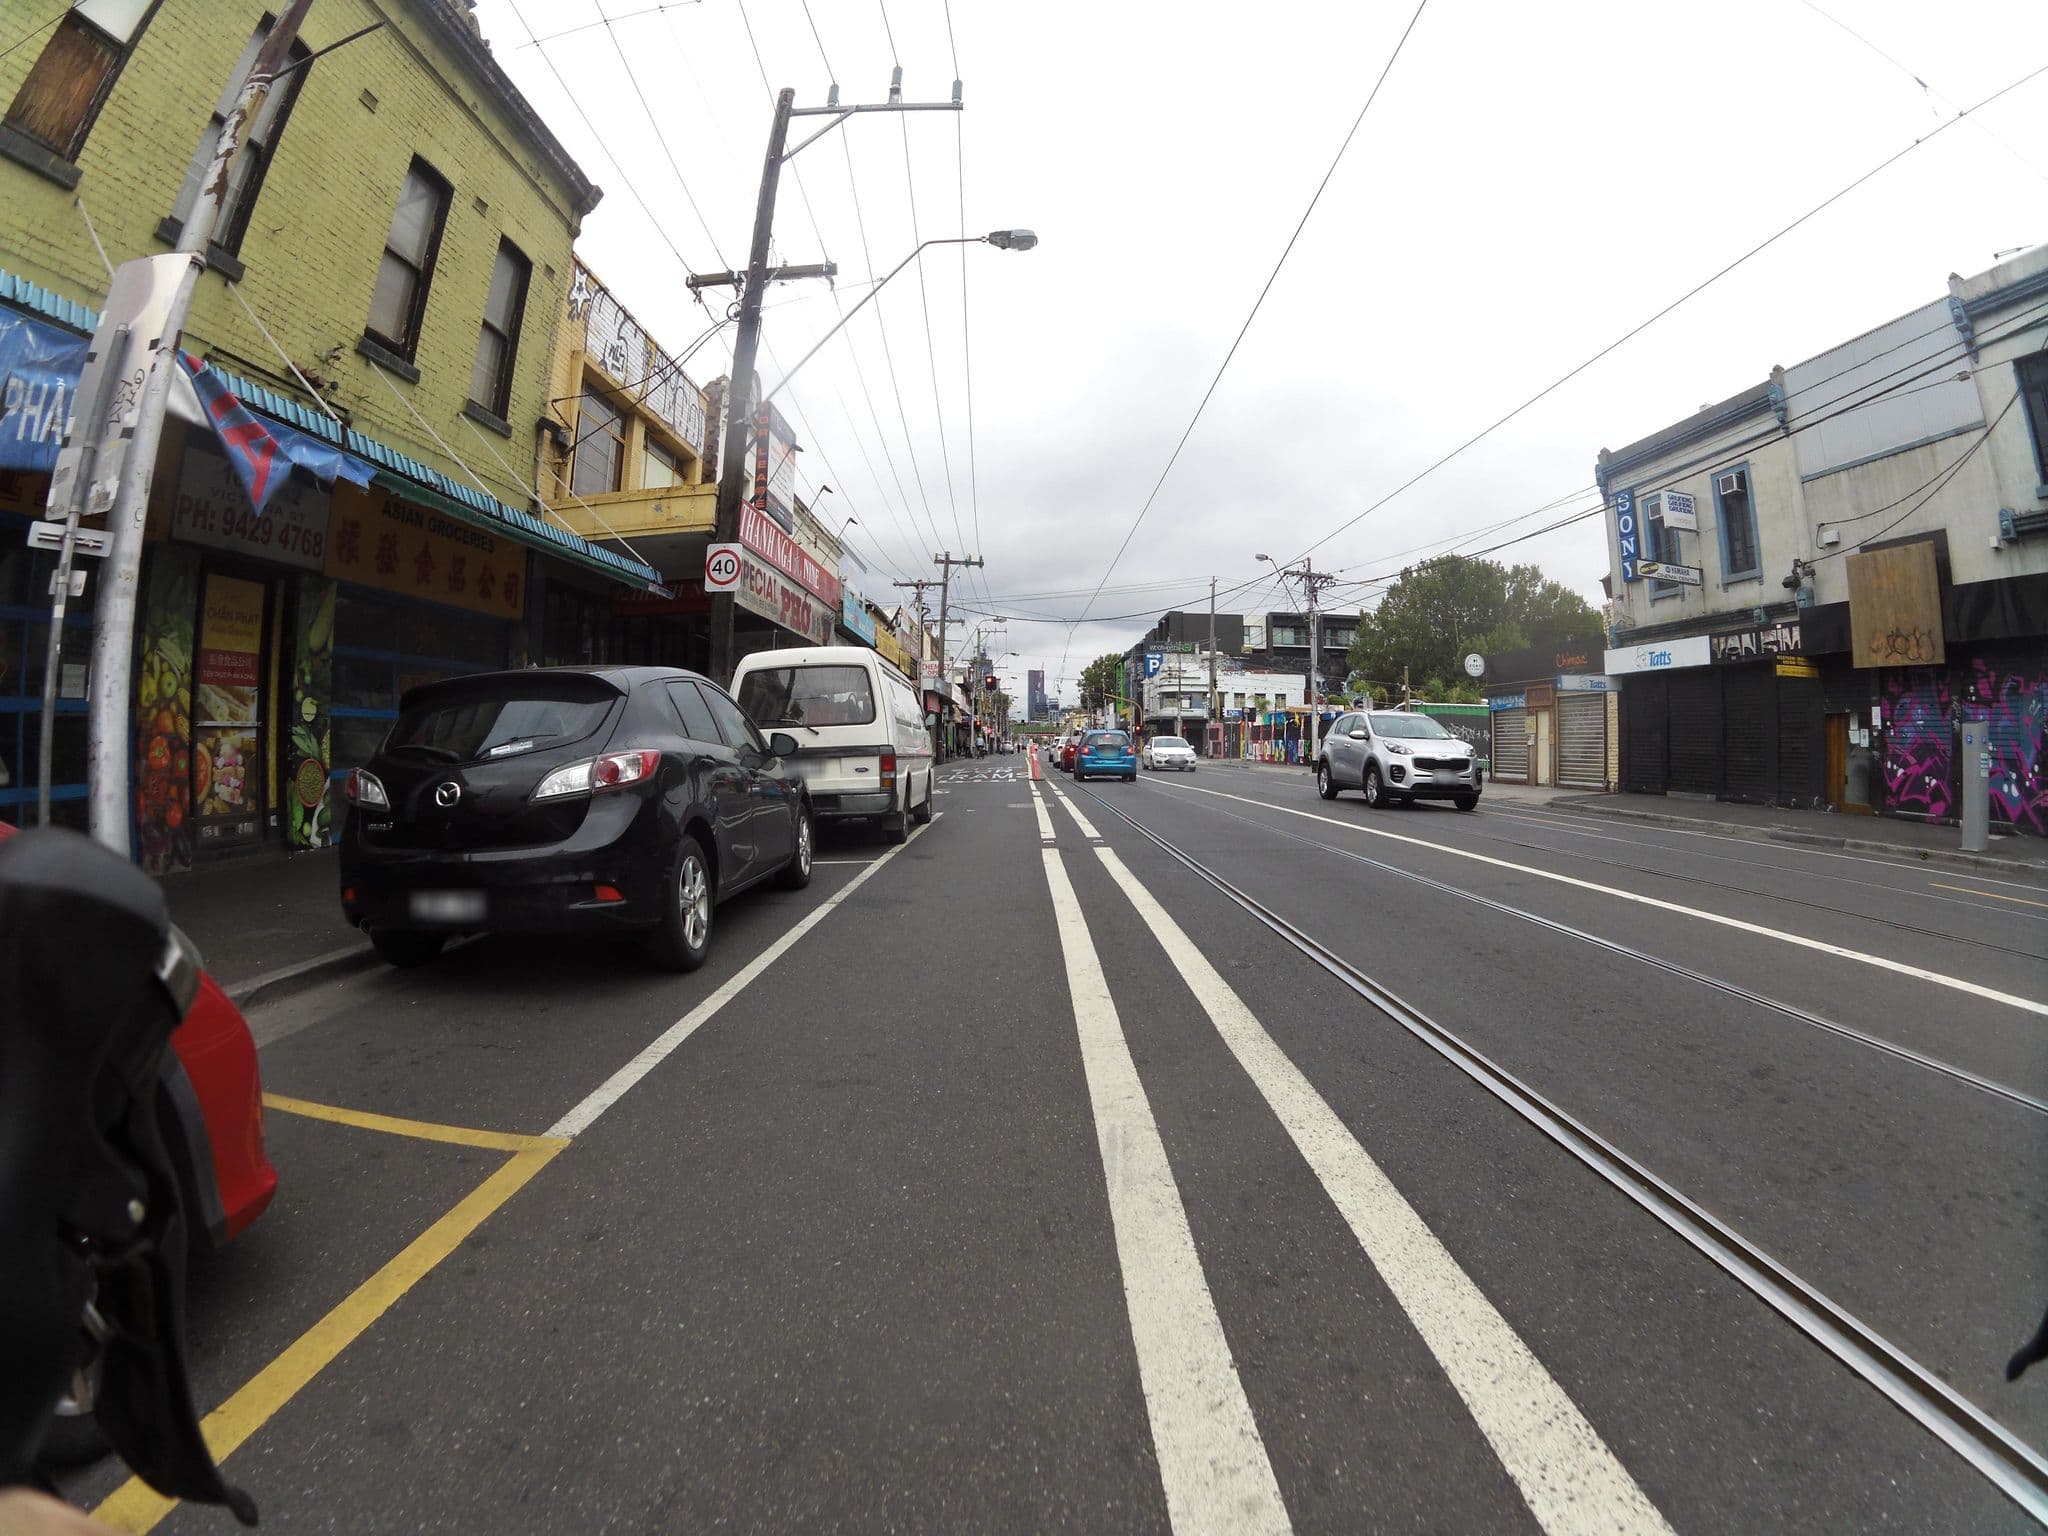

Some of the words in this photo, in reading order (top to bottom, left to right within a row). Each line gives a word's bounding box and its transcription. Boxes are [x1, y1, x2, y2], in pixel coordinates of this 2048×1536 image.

[176, 494, 216, 532] PH:
[222, 507, 273, 545] 9429
[279, 522, 323, 557] 4768
[382, 500, 424, 528] ASIAN
[427, 516, 496, 553] GROCERIES
[740, 503, 775, 560] THANH
[775, 535, 793, 572] NGA
[711, 558, 735, 575] 40
[1149, 660, 1160, 672] P
[1648, 650, 1672, 667] Tatts
[1589, 679, 1607, 689] Tatts
